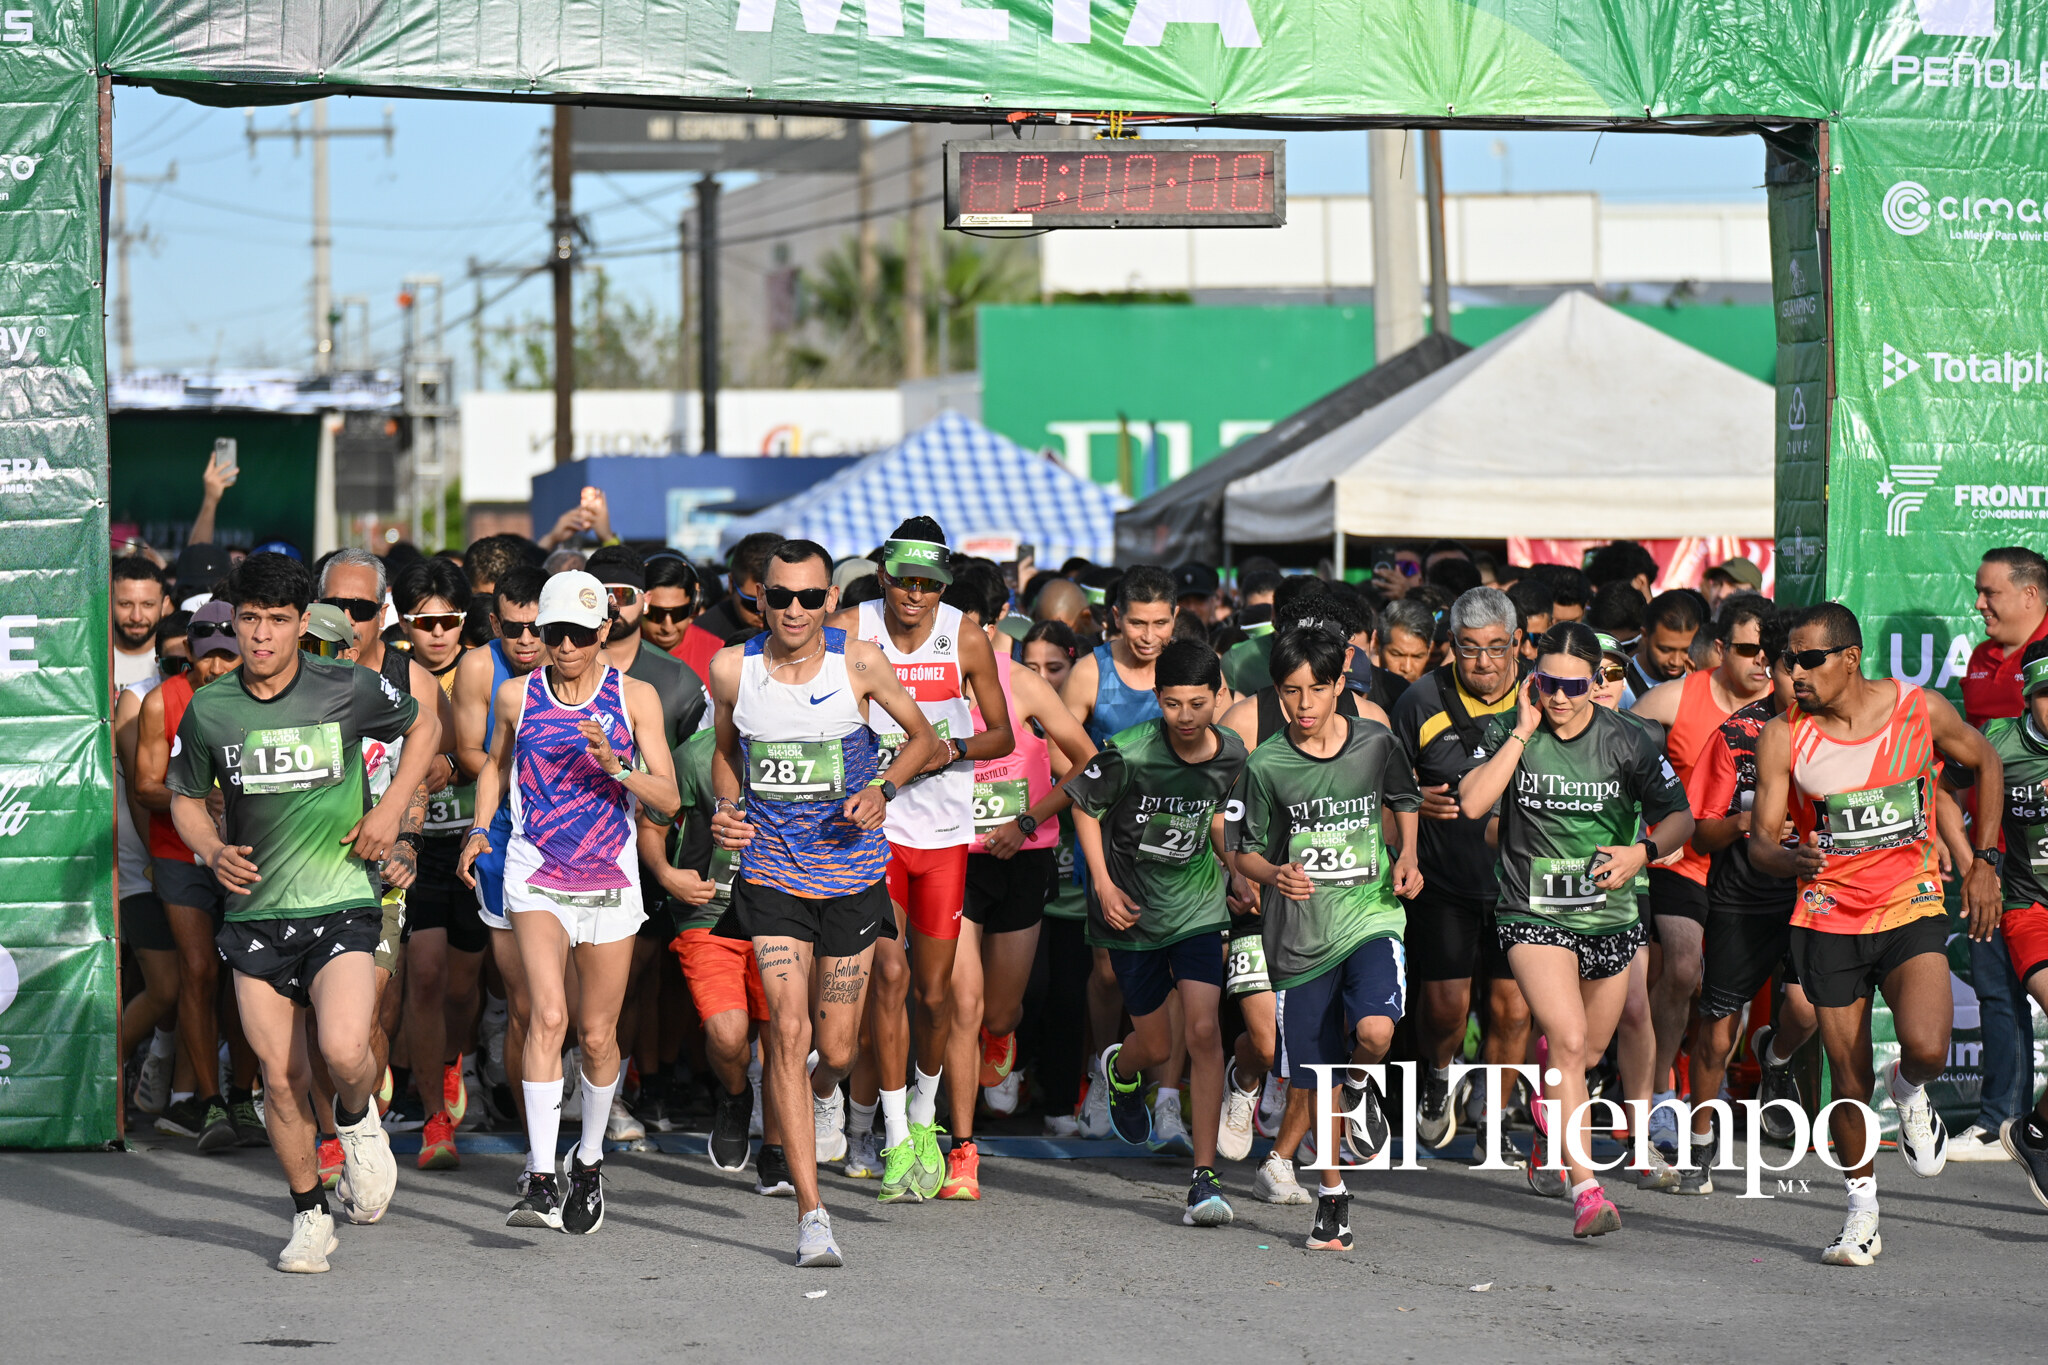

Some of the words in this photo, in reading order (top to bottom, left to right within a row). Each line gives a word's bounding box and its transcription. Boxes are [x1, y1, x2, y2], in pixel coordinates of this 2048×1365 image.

[1995, 230, 2018, 241] Para
[2019, 231, 2042, 241] Vivir
[1954, 484, 2048, 508] FRONT
[1971, 509, 2048, 519] CONORDENYR
[909, 664, 945, 681] GÓMEZ
[253, 744, 314, 774] 150
[330, 736, 342, 779] MEDALLA
[759, 758, 816, 784] 287
[831, 753, 842, 793] MEDALLA
[975, 766, 1009, 782] CASTILLO
[1517, 769, 1538, 795] El
[1542, 773, 1620, 802] Tiempo
[1846, 788, 1884, 799] CARRERA
[427, 798, 462, 823] 31
[1287, 801, 1311, 823] El
[1517, 796, 1541, 810] de
[1544, 798, 1604, 812] todos
[1841, 801, 1901, 831] 146
[1910, 788, 1921, 826] MEDALLA
[2011, 805, 2036, 818] de
[1314, 816, 1370, 833] todos
[1160, 828, 1197, 851] 22
[1300, 845, 1358, 871] 236
[1542, 873, 1597, 897] 118
[1228, 950, 1268, 978] 587
